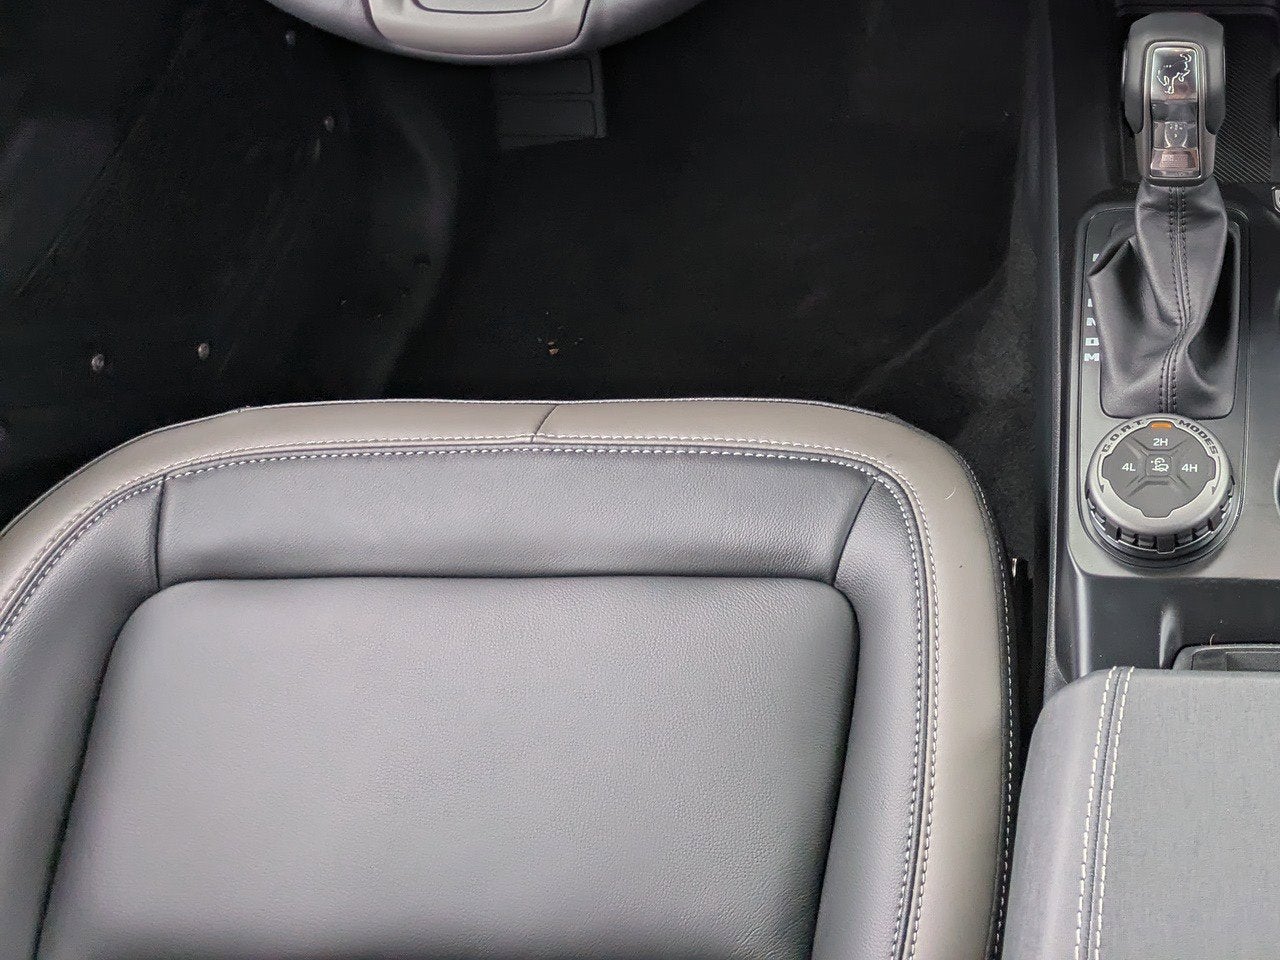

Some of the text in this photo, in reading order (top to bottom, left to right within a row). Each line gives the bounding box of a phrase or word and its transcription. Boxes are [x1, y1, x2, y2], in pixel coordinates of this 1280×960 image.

[1085, 337, 1100, 346] D
[1084, 352, 1100, 362] M
[1178, 419, 1219, 455] MODES
[1153, 438, 1169, 446] 2H
[1121, 464, 1136, 472] 4L
[1181, 464, 1198, 472] 4H
